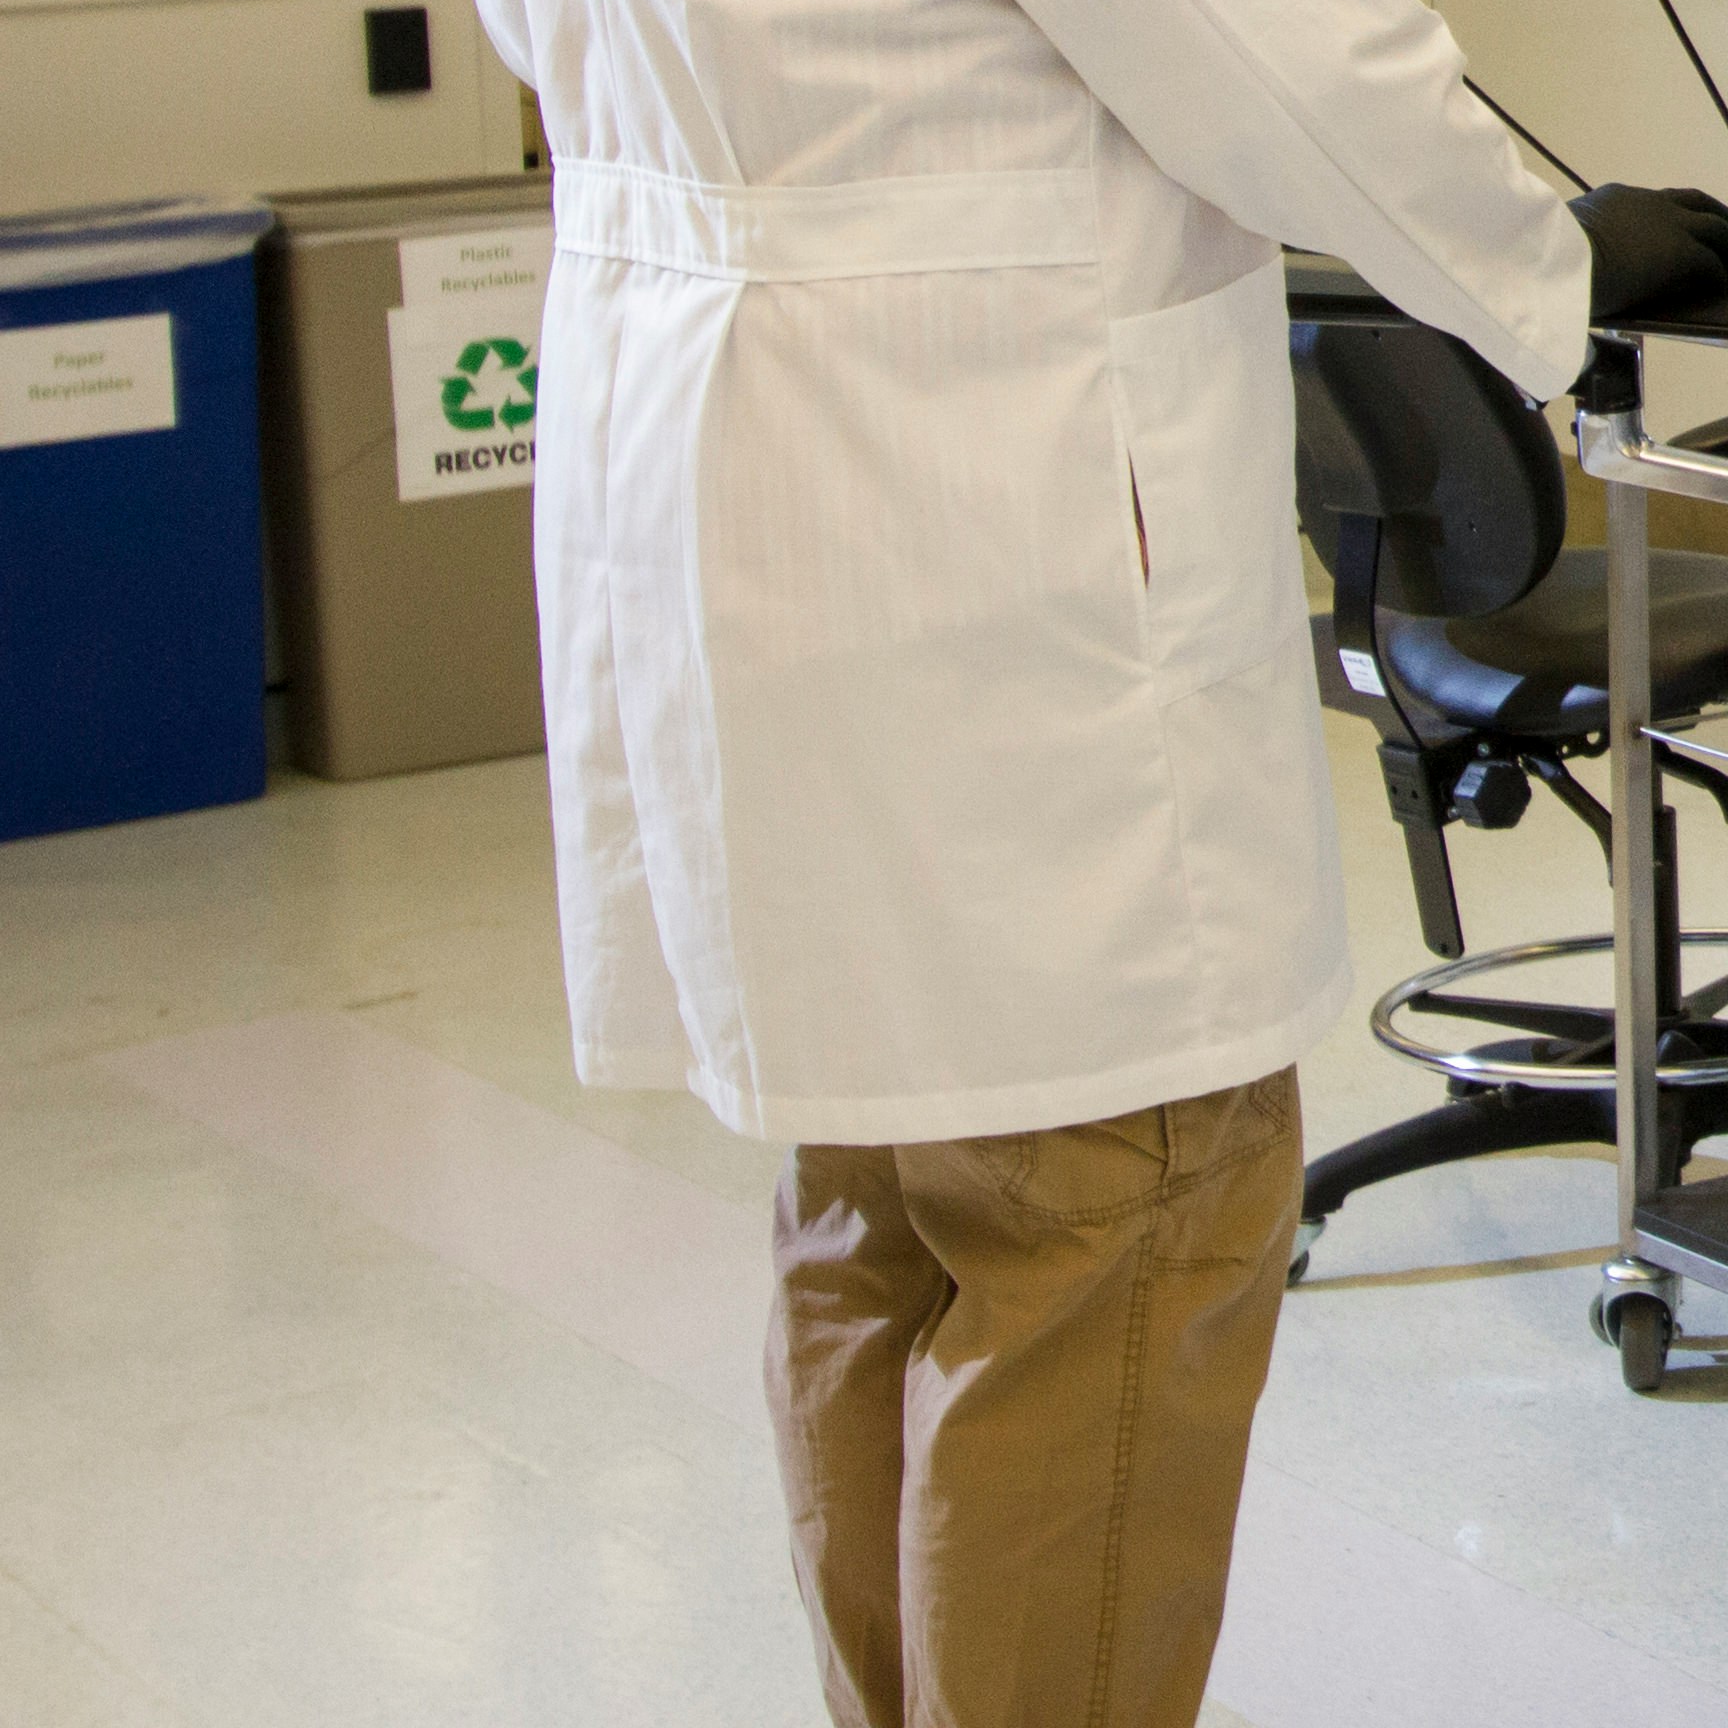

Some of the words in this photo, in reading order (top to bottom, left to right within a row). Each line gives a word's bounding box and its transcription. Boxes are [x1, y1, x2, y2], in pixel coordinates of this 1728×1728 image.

[460, 243, 514, 264] Plastic
[441, 268, 537, 294] Recyclables
[54, 348, 105, 372] Paper
[28, 374, 134, 403] Recyclables
